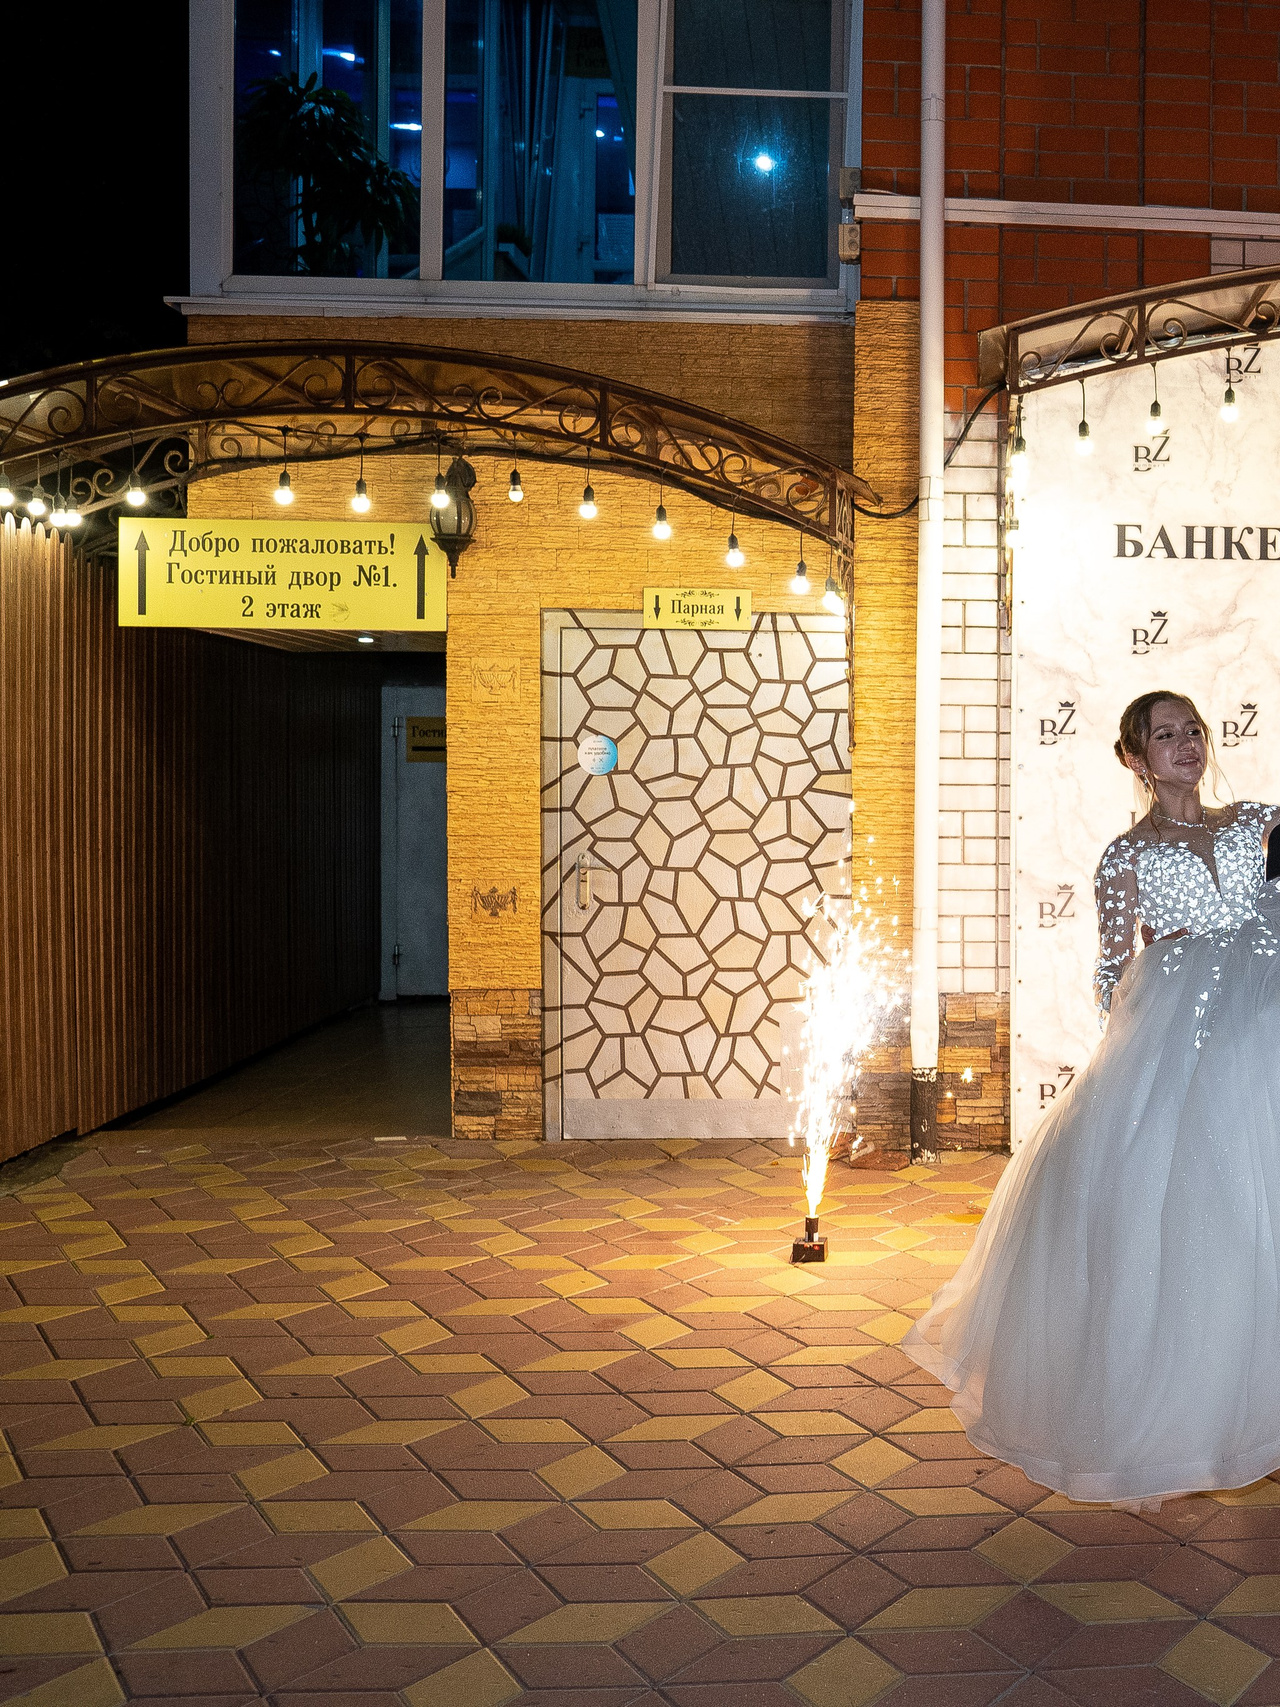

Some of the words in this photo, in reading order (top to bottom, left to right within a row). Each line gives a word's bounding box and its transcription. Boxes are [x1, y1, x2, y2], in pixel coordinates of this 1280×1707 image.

[169, 530, 240, 557] Добро
[251, 533, 396, 556] пожаловать!
[166, 562, 277, 586] Гостиный
[288, 568, 342, 591] двор
[353, 564, 398, 588] №1.
[241, 595, 254, 618] 2
[266, 600, 321, 618] этаж
[671, 600, 725, 617] Парная
